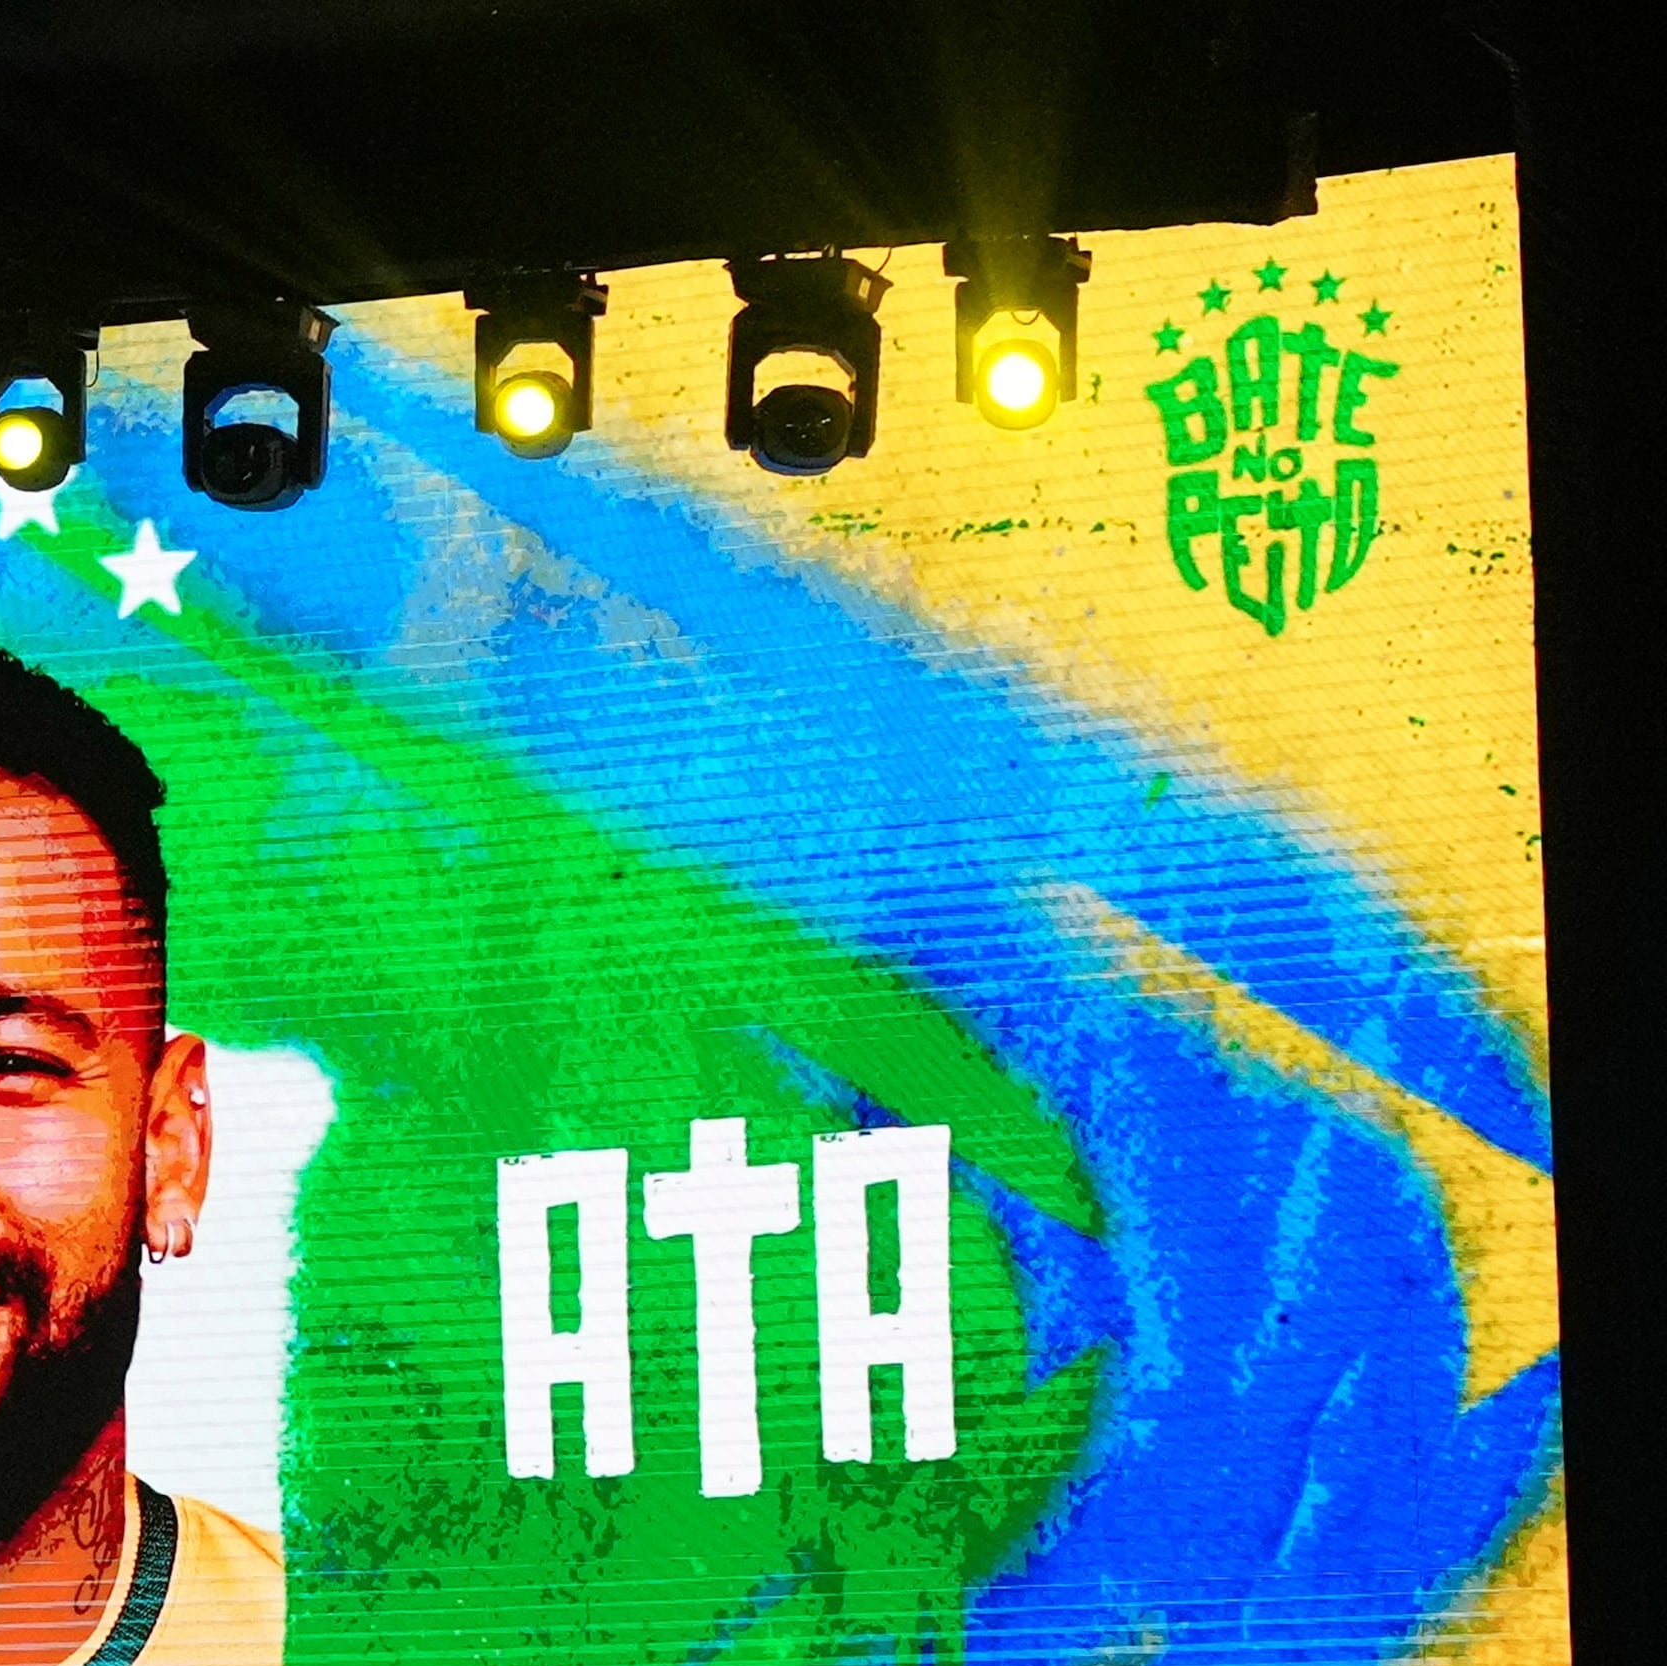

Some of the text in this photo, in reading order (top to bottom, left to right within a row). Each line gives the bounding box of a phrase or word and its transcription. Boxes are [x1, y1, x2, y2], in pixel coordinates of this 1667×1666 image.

[1146, 315, 1398, 466] BATE
[1231, 443, 1304, 482] NO
[1165, 460, 1379, 637] PEITO
[497, 1117, 958, 1497] ATA
